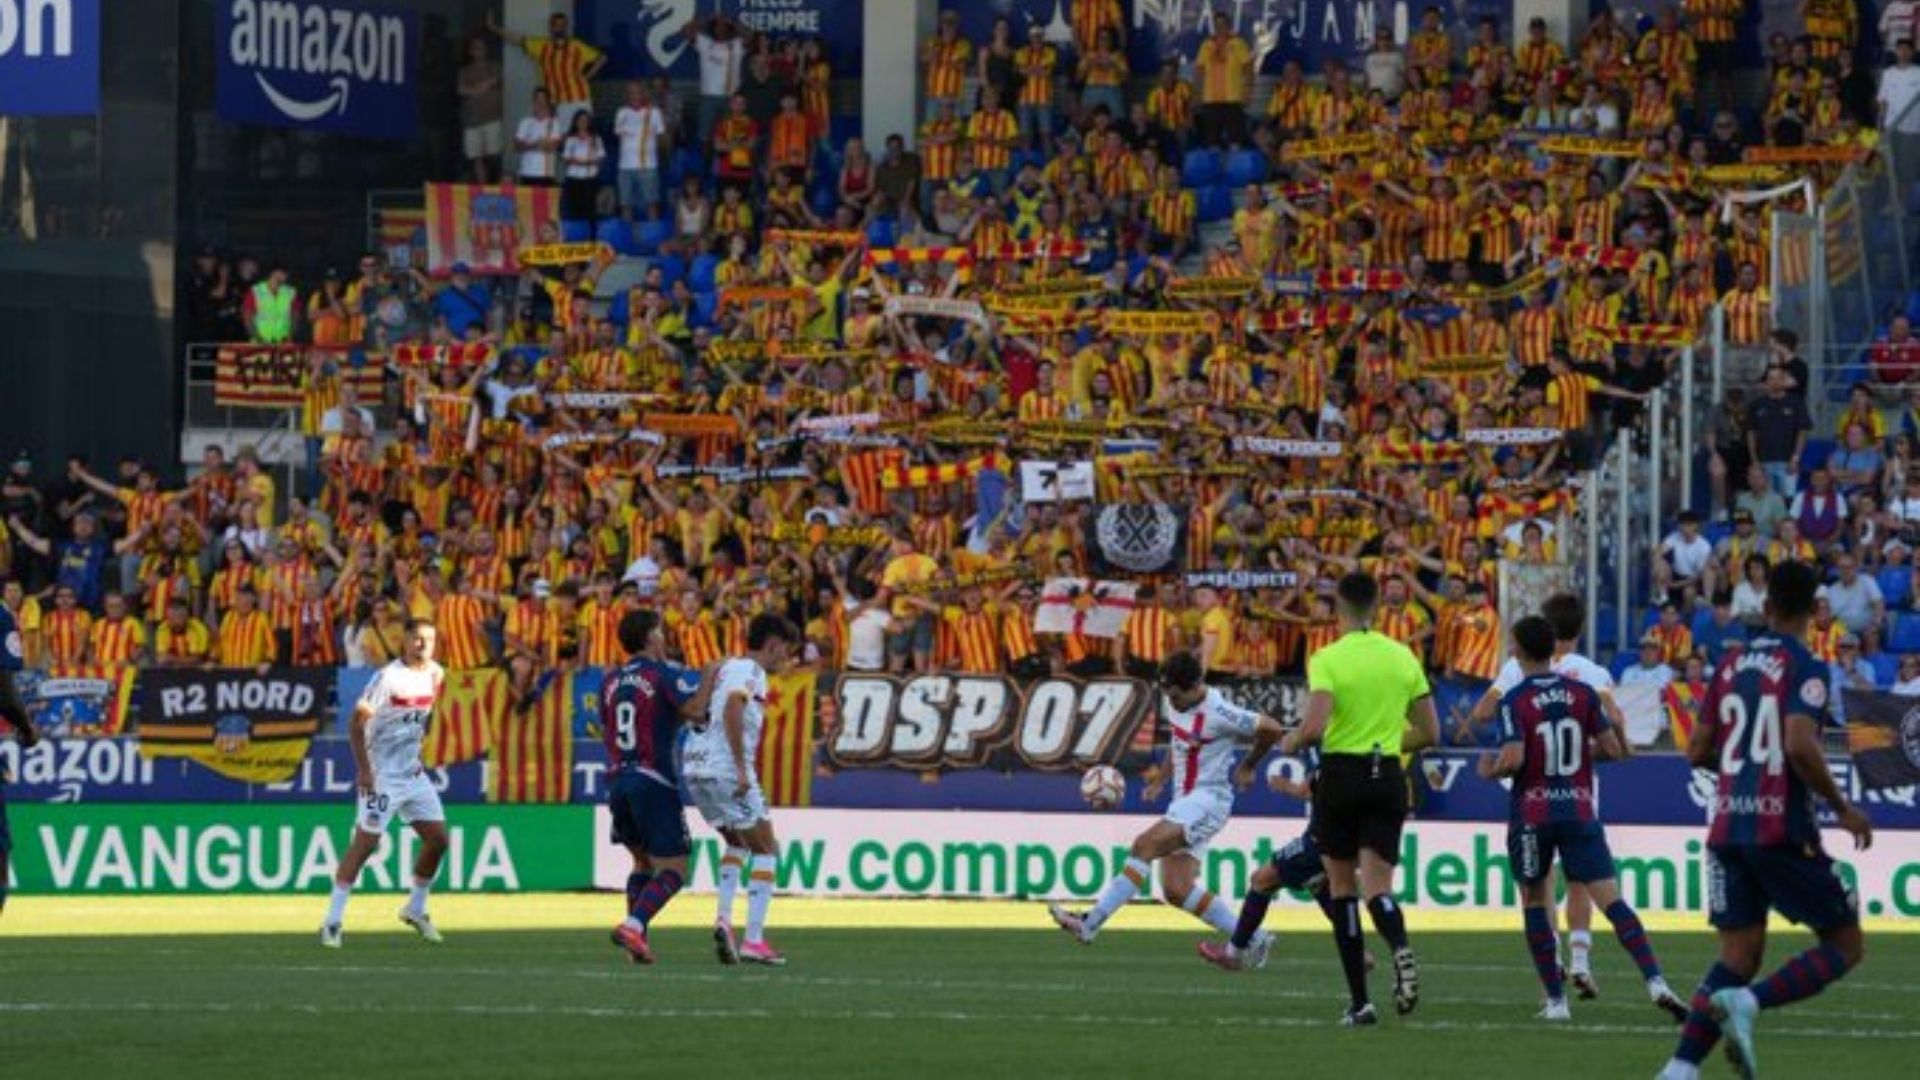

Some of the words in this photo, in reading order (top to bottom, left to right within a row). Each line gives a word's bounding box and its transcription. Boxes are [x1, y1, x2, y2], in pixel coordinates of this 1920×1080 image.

[230, 0, 405, 84] amazon
[738, 10, 819, 32] SIEMPRE
[162, 682, 206, 716] R2
[217, 680, 315, 714] NORD
[835, 676, 1006, 753] DSP
[1020, 679, 1135, 757] 07
[615, 701, 637, 751] 9
[1535, 717, 1583, 777] 10
[1719, 693, 1785, 776] 24
[366, 792, 390, 813] 20
